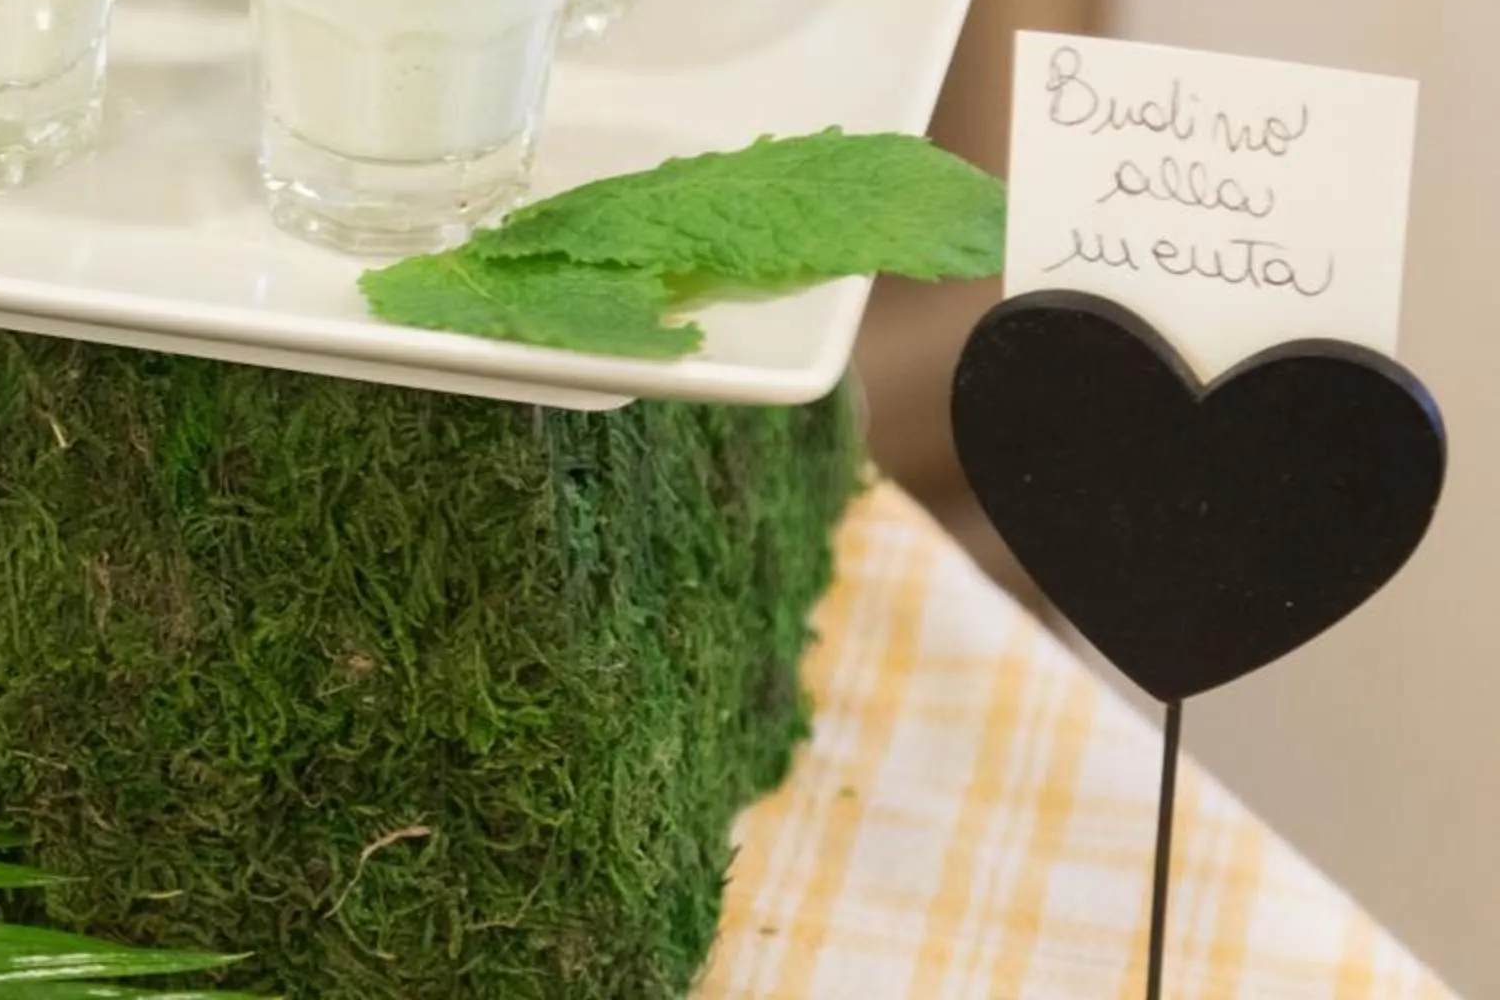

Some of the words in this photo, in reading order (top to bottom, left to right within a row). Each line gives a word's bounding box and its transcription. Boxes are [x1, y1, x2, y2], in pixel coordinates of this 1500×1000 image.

[1046, 46, 1309, 156] Budino
[1097, 157, 1275, 218] alla
[1042, 227, 1334, 297] menta
